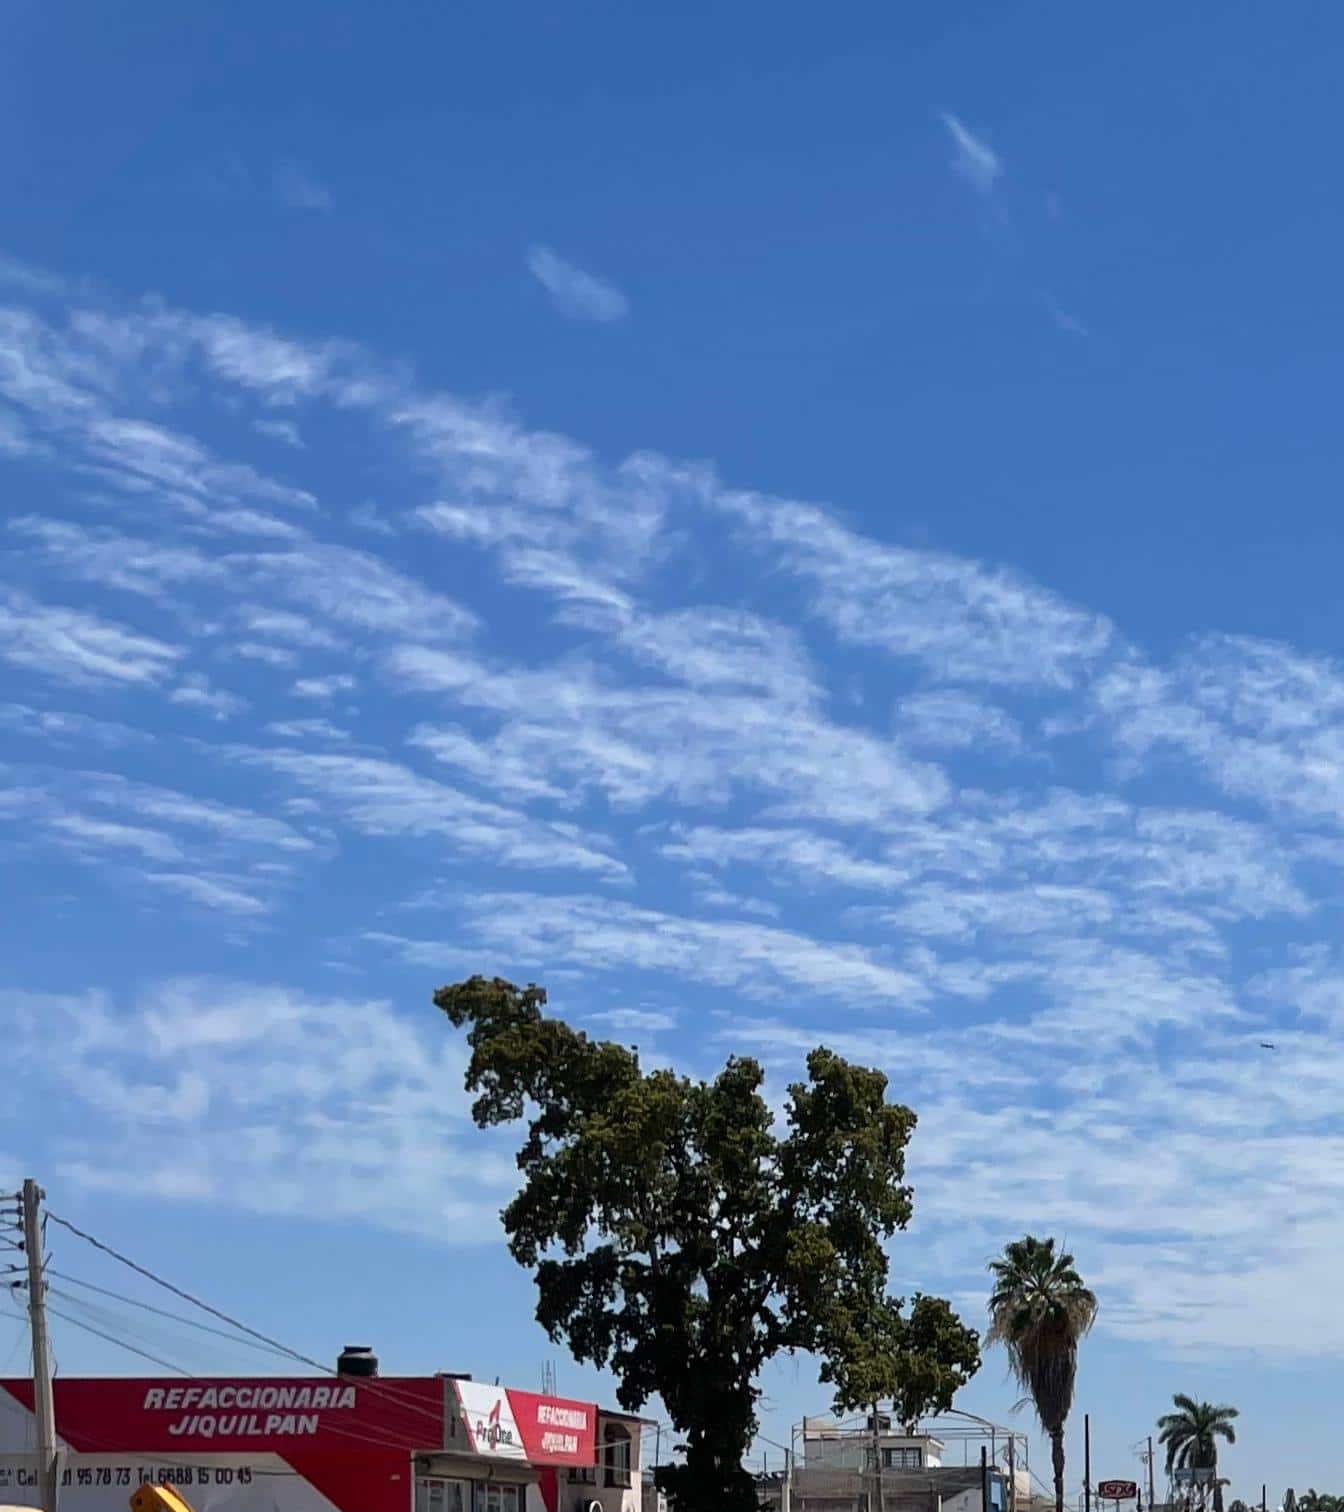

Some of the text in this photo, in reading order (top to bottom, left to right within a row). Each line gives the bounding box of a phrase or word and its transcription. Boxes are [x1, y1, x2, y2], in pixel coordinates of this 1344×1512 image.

[144, 1386, 356, 1409] REFACCIONARIA
[168, 1415, 319, 1438] JIQUILPAN
[77, 1467, 92, 1486] 95
[96, 1467, 112, 1486] 78
[116, 1467, 130, 1486] 73
[215, 1467, 234, 1485] 00
